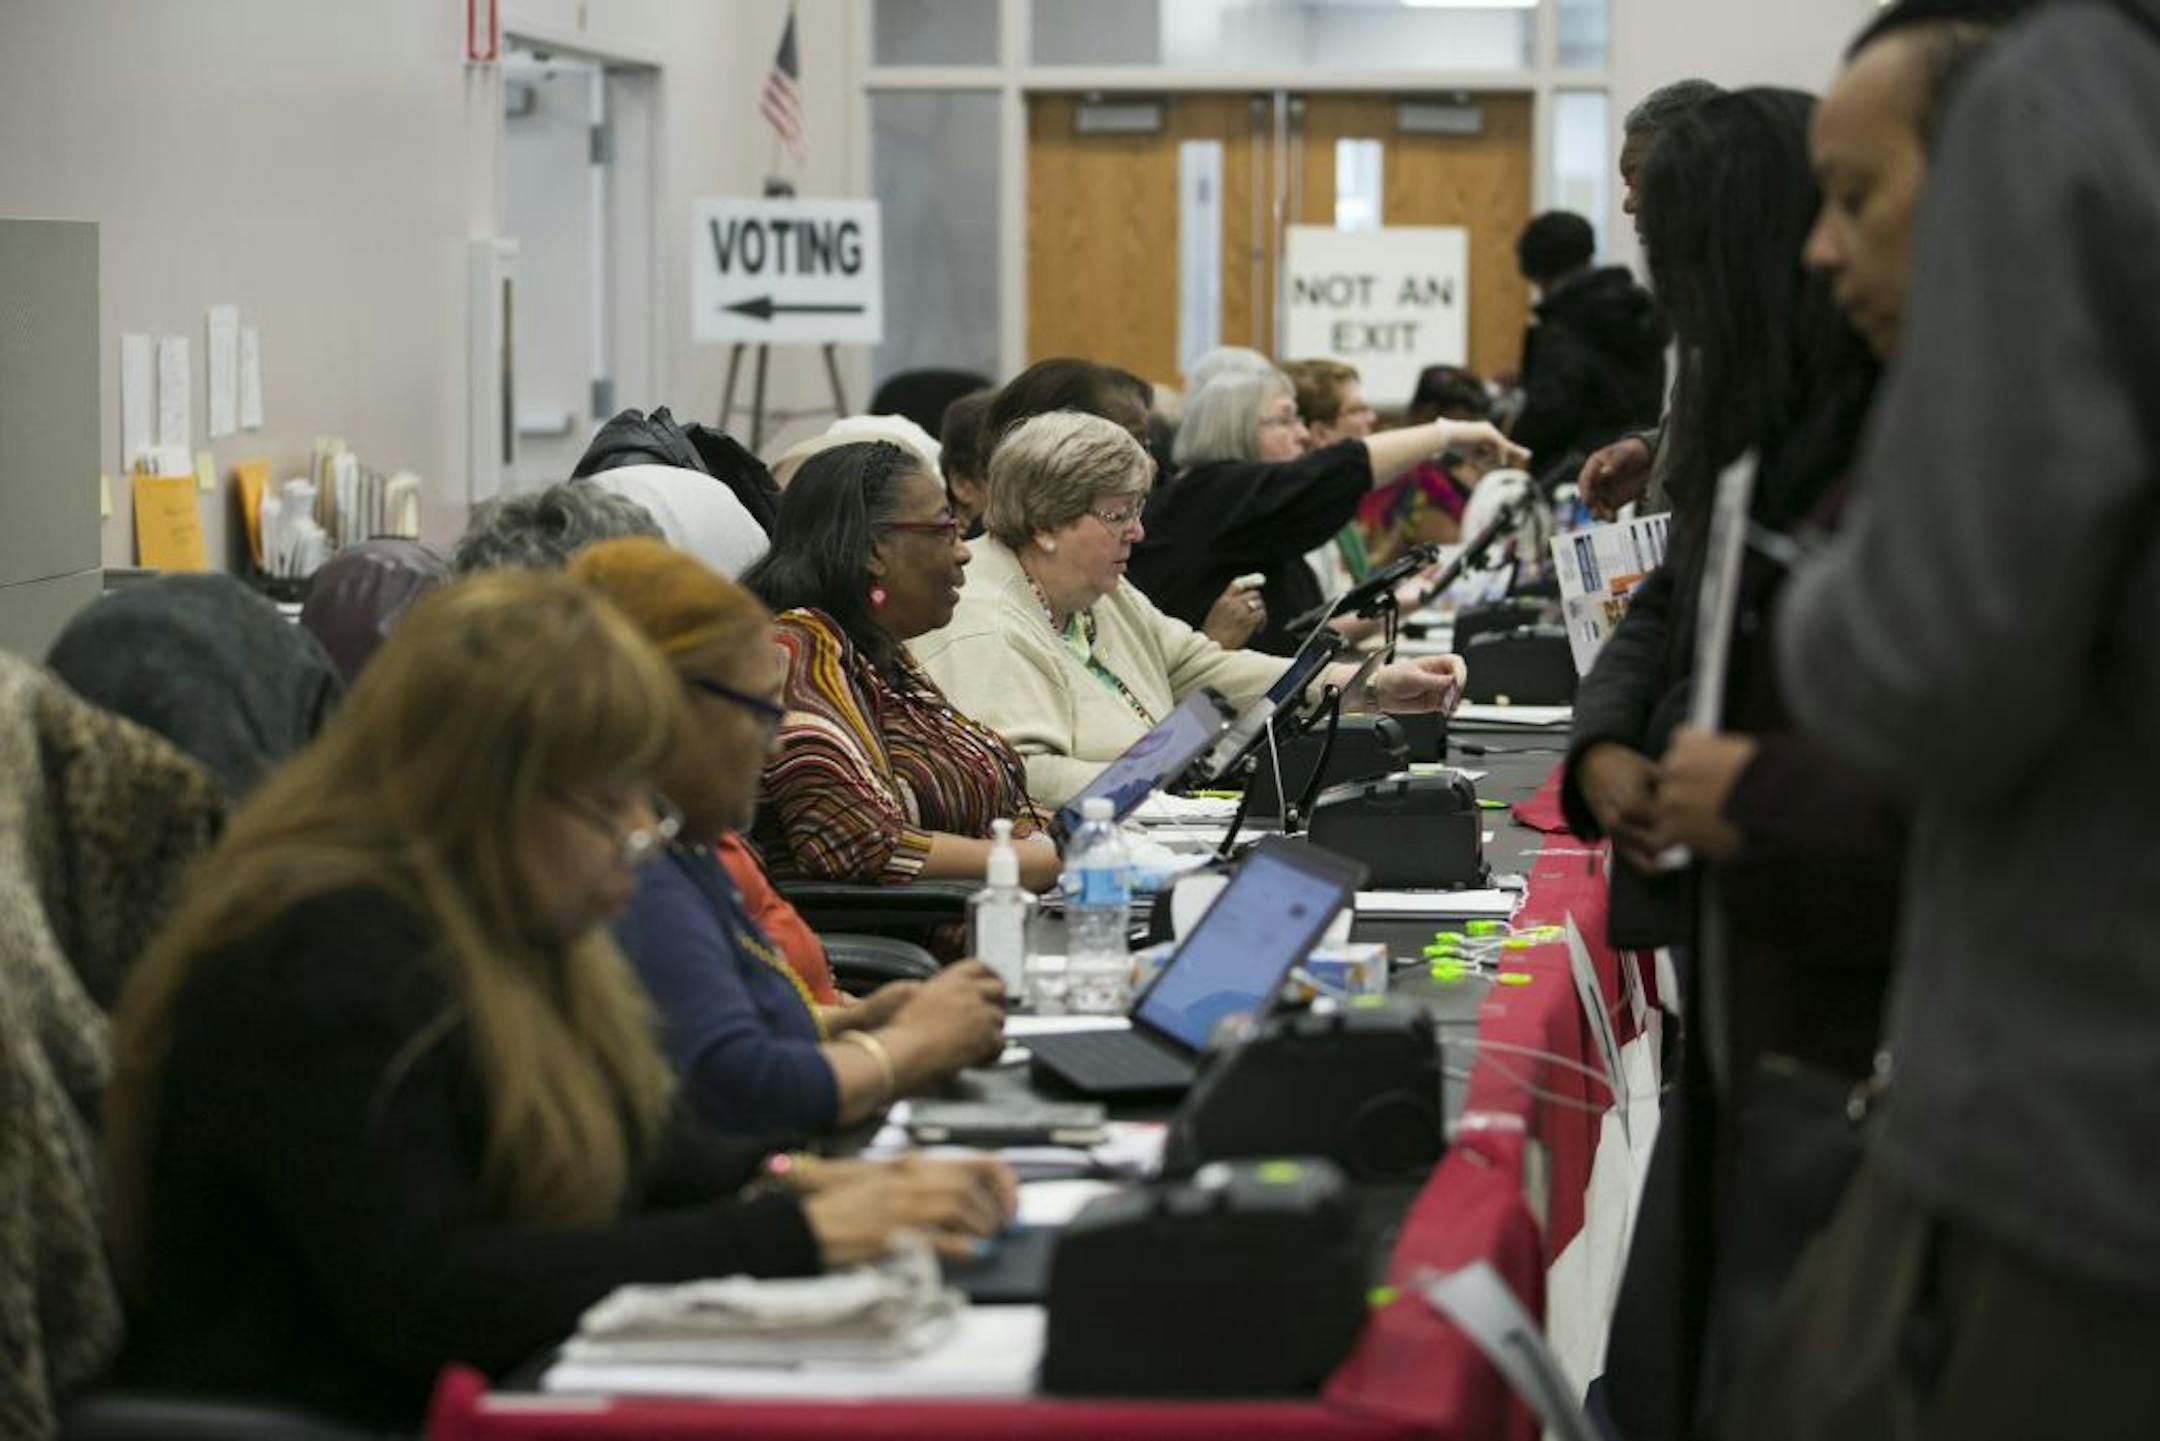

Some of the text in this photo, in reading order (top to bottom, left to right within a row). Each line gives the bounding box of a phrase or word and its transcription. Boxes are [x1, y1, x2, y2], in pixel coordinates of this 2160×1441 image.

[709, 217, 863, 275] VOTING
[1292, 275, 1455, 307] NOT AN
[1332, 321, 1417, 354] EXIT
